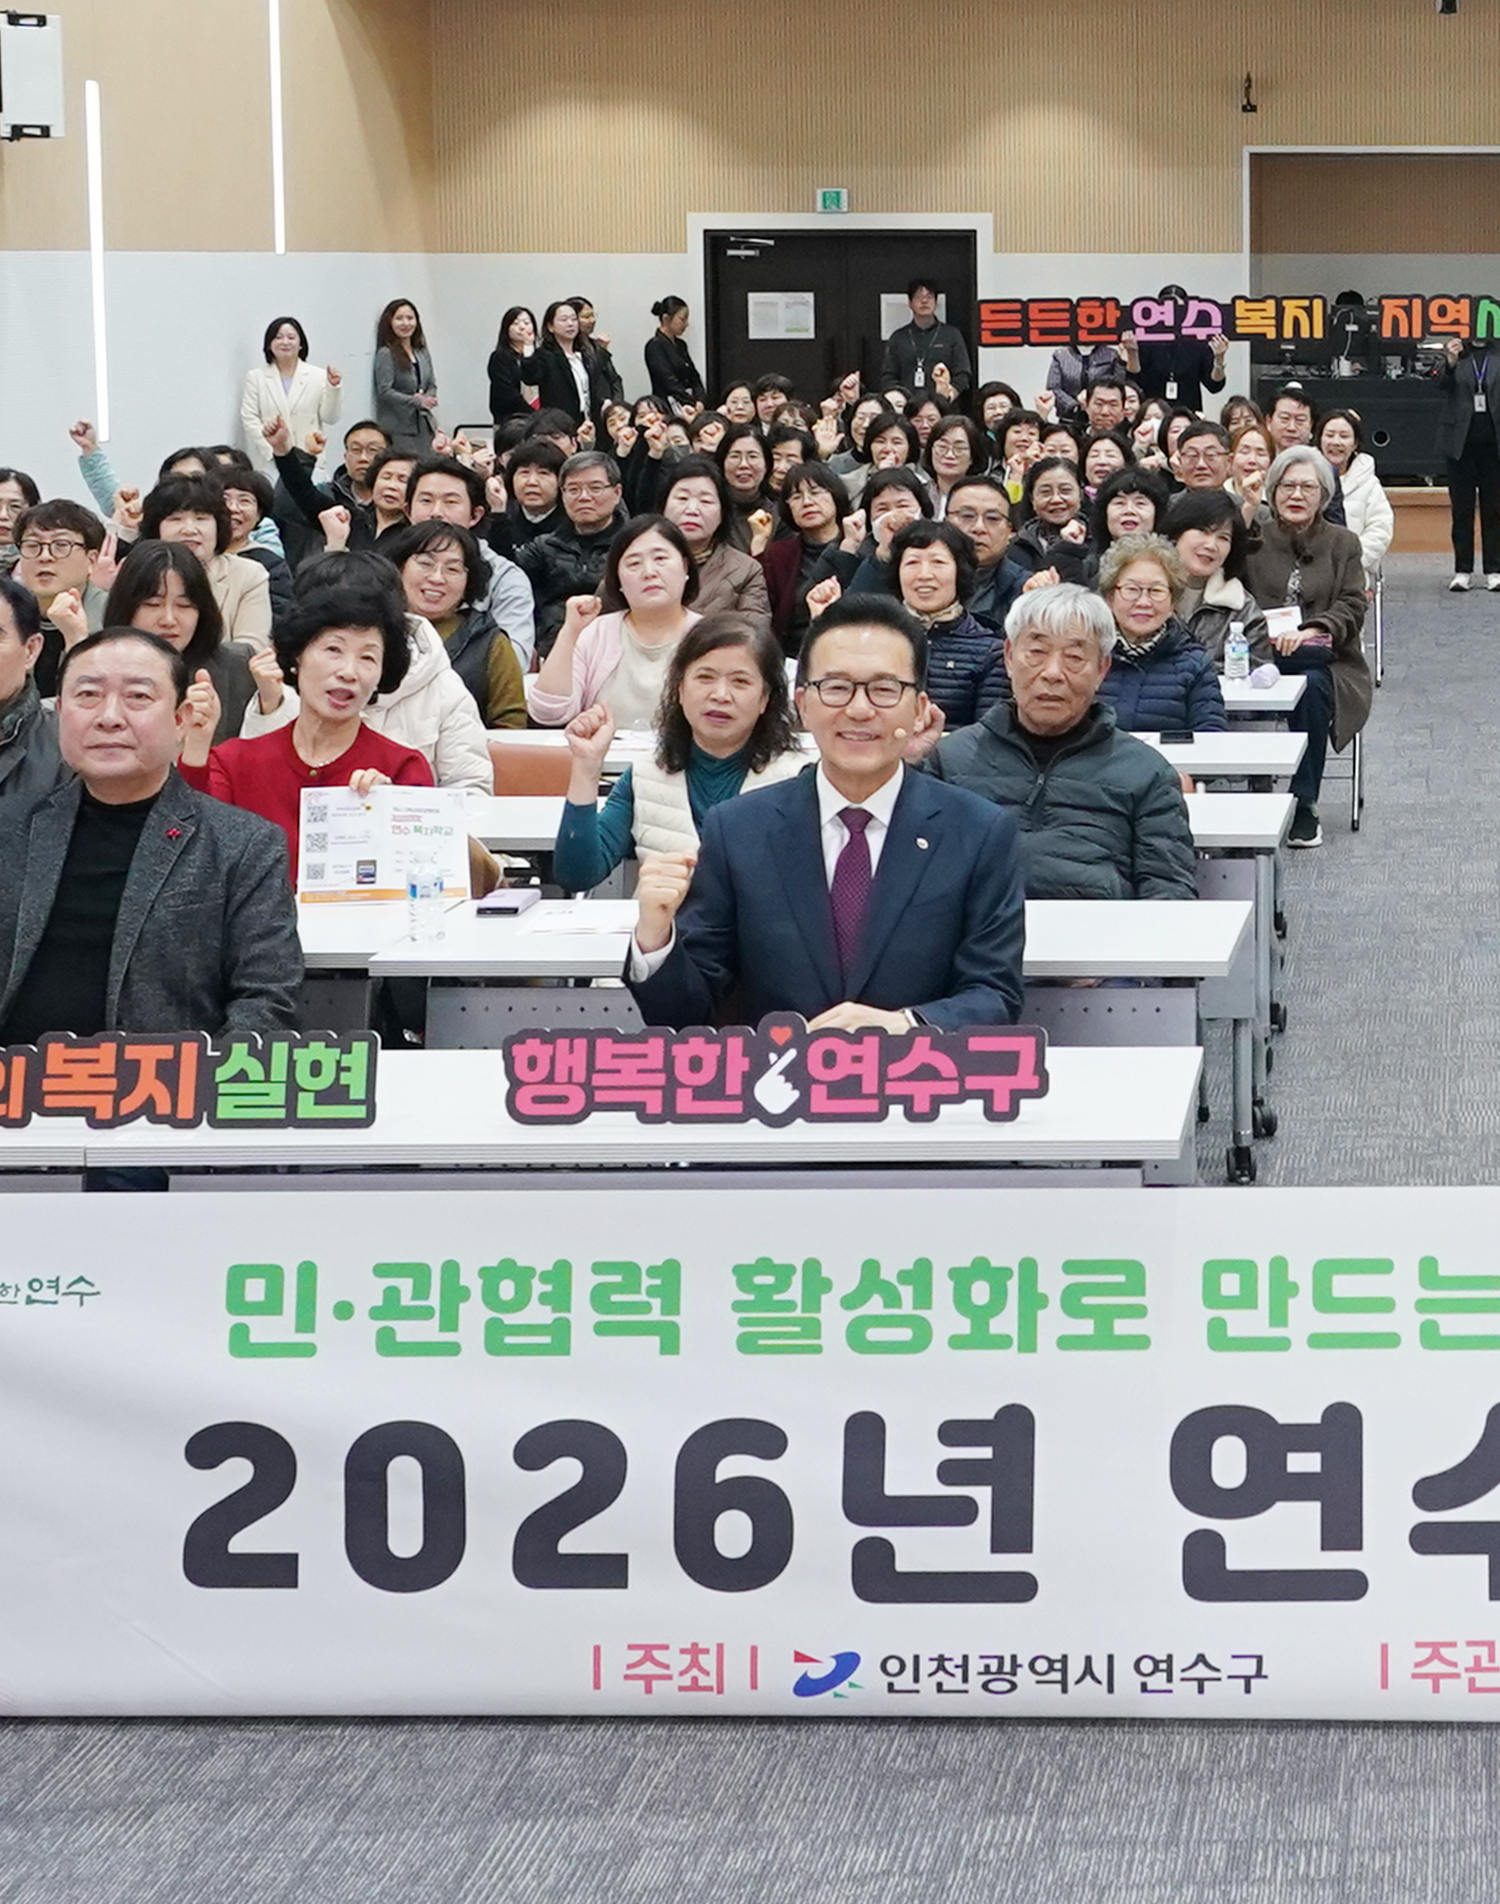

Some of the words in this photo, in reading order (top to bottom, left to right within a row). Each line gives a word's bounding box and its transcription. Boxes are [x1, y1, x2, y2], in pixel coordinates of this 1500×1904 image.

[980, 300, 1122, 344] 든든한
[1132, 299, 1223, 341] 연수
[1235, 298, 1324, 339] 복지
[41, 1041, 198, 1121] 복지
[213, 1033, 370, 1120] 실현
[511, 1035, 751, 1118] 행복한
[806, 1034, 1042, 1116] 연수구
[225, 1257, 682, 1358] 민·관협력
[731, 1256, 1151, 1355] 활성화로
[181, 1402, 1040, 1605] 2026년
[622, 1642, 726, 1696] 주최
[879, 1652, 1116, 1696] 인천광역시
[1132, 1652, 1269, 1696] 연수구
